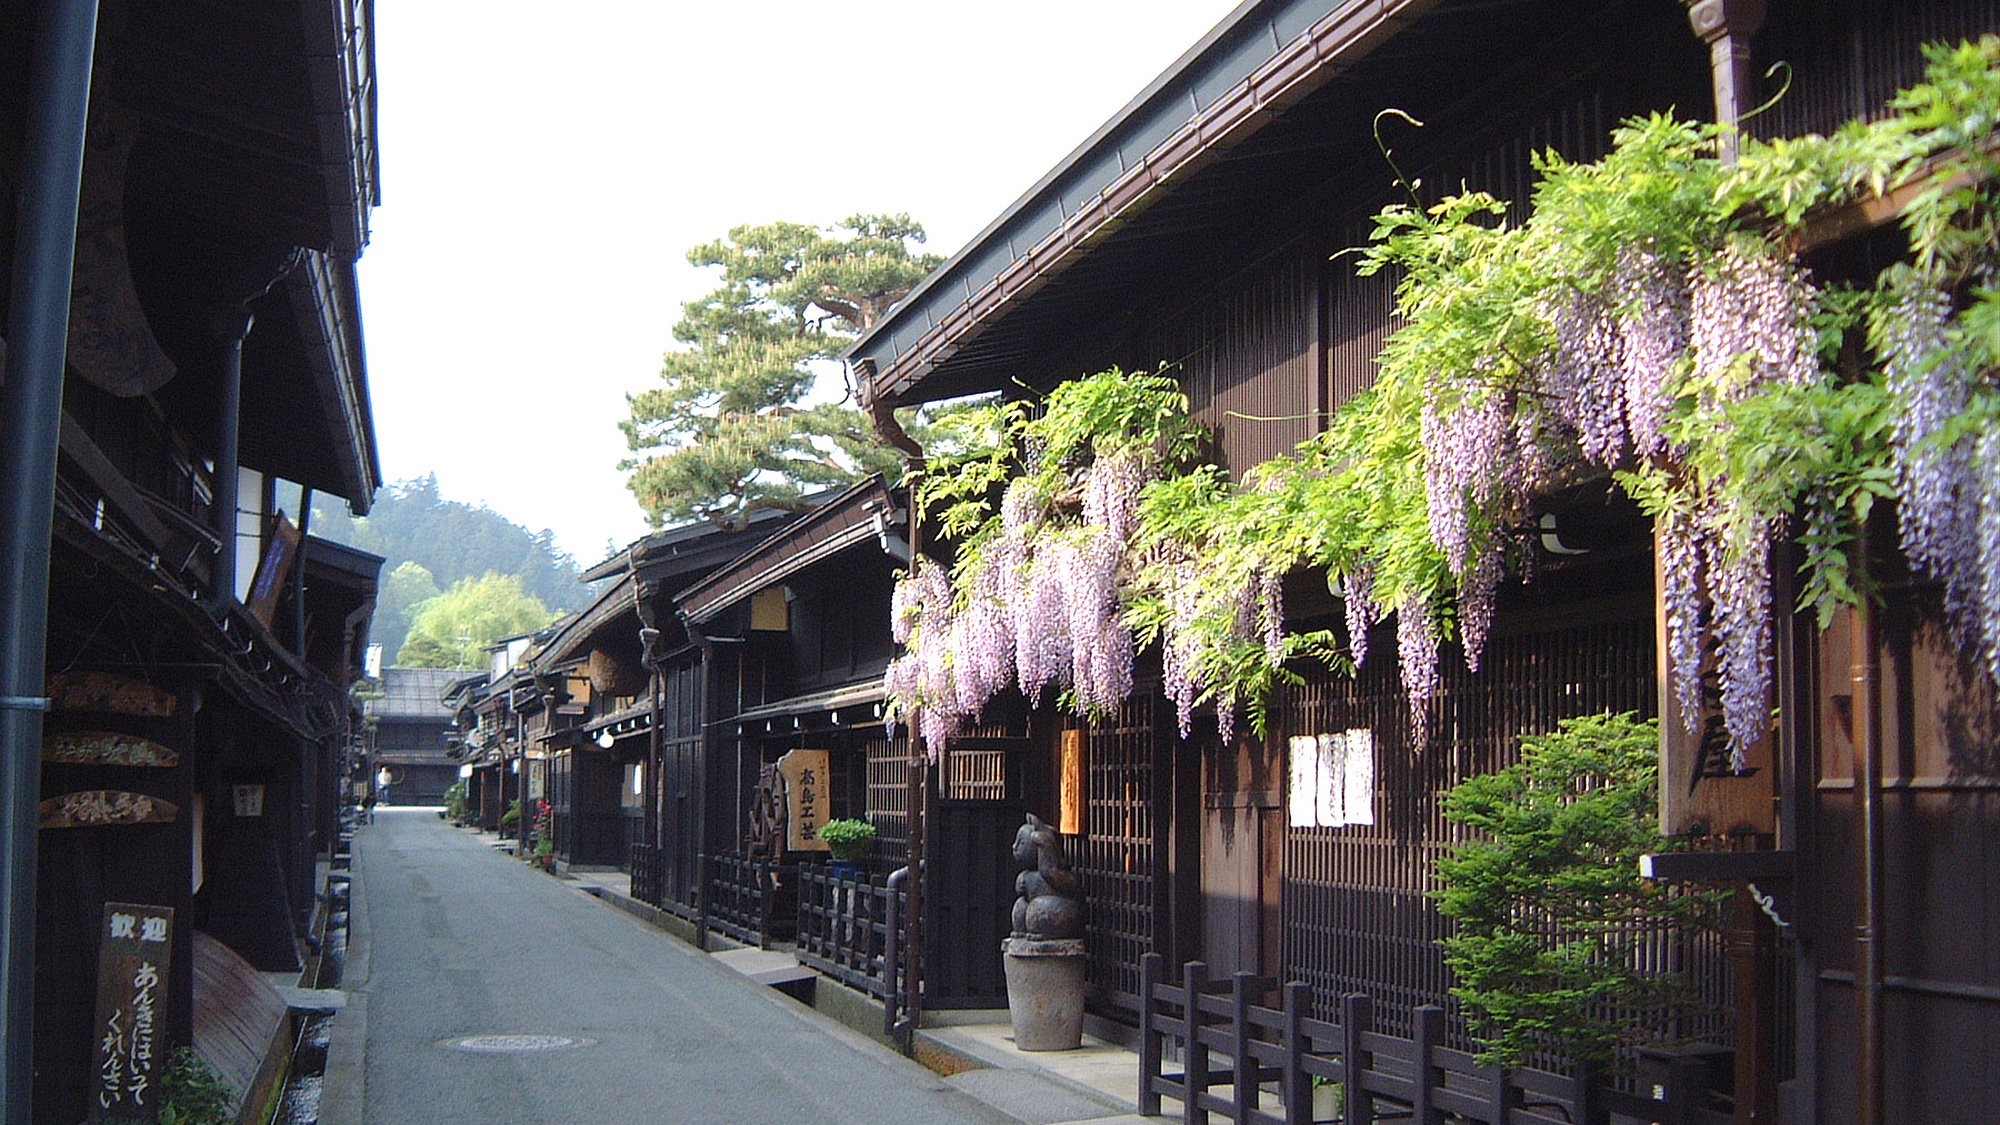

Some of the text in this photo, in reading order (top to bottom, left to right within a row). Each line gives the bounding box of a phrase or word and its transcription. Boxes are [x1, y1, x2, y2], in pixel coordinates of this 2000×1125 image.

[110, 912, 167, 942] 歓迎
[100, 1008, 125, 1109] くれんさい
